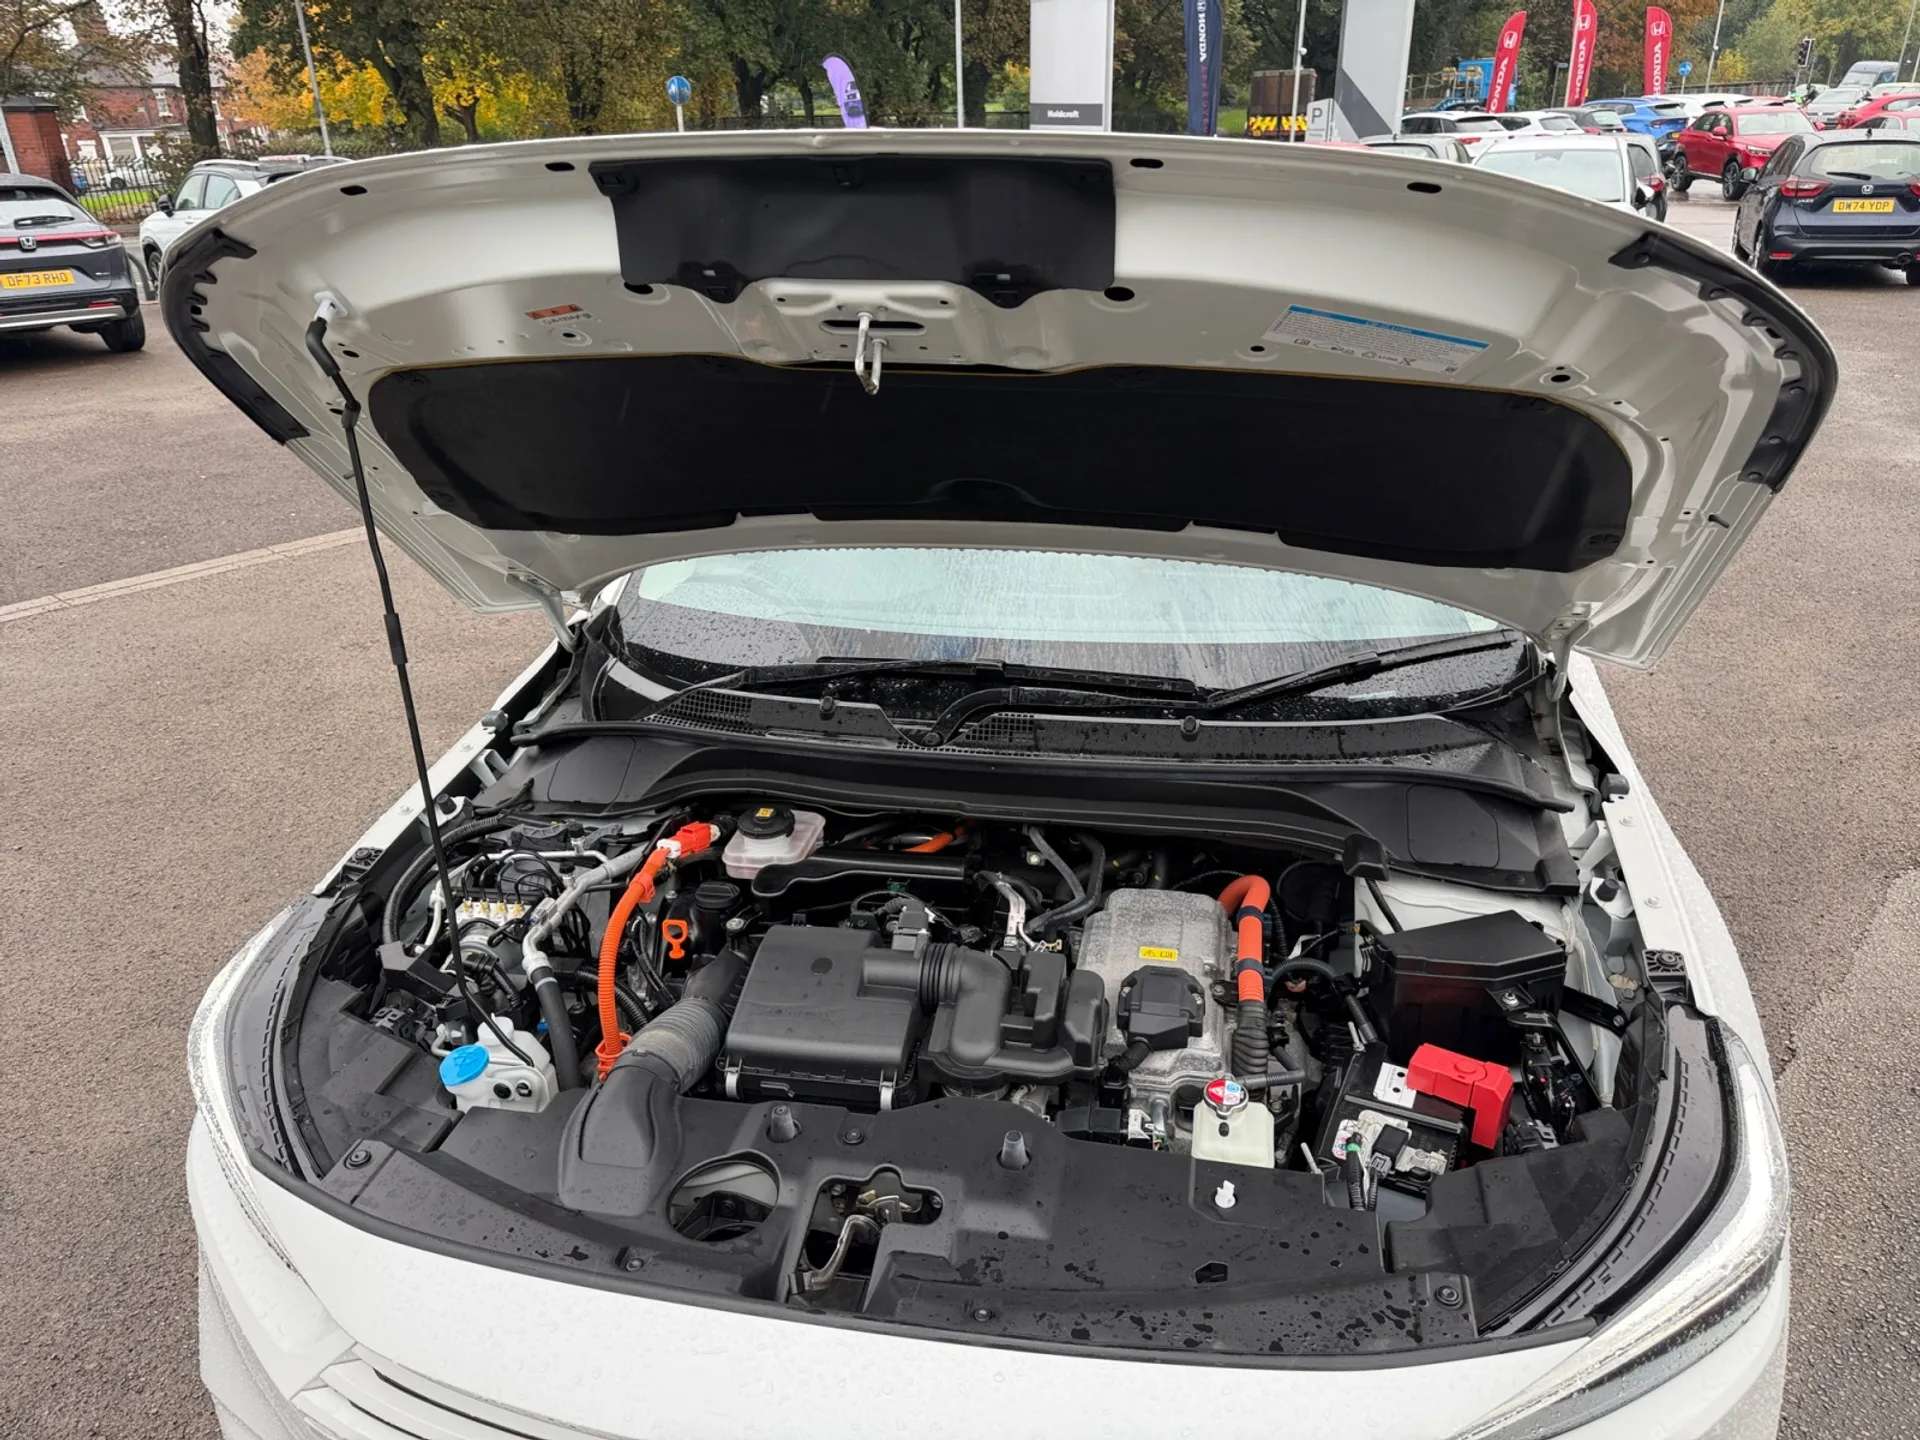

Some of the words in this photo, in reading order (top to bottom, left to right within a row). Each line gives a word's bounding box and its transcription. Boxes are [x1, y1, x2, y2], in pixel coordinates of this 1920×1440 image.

[1198, 13, 1207, 62] HONDA
[1490, 57, 1509, 113] ONDA
[1311, 107, 1323, 124] P
[7, 274, 40, 287] DF73
